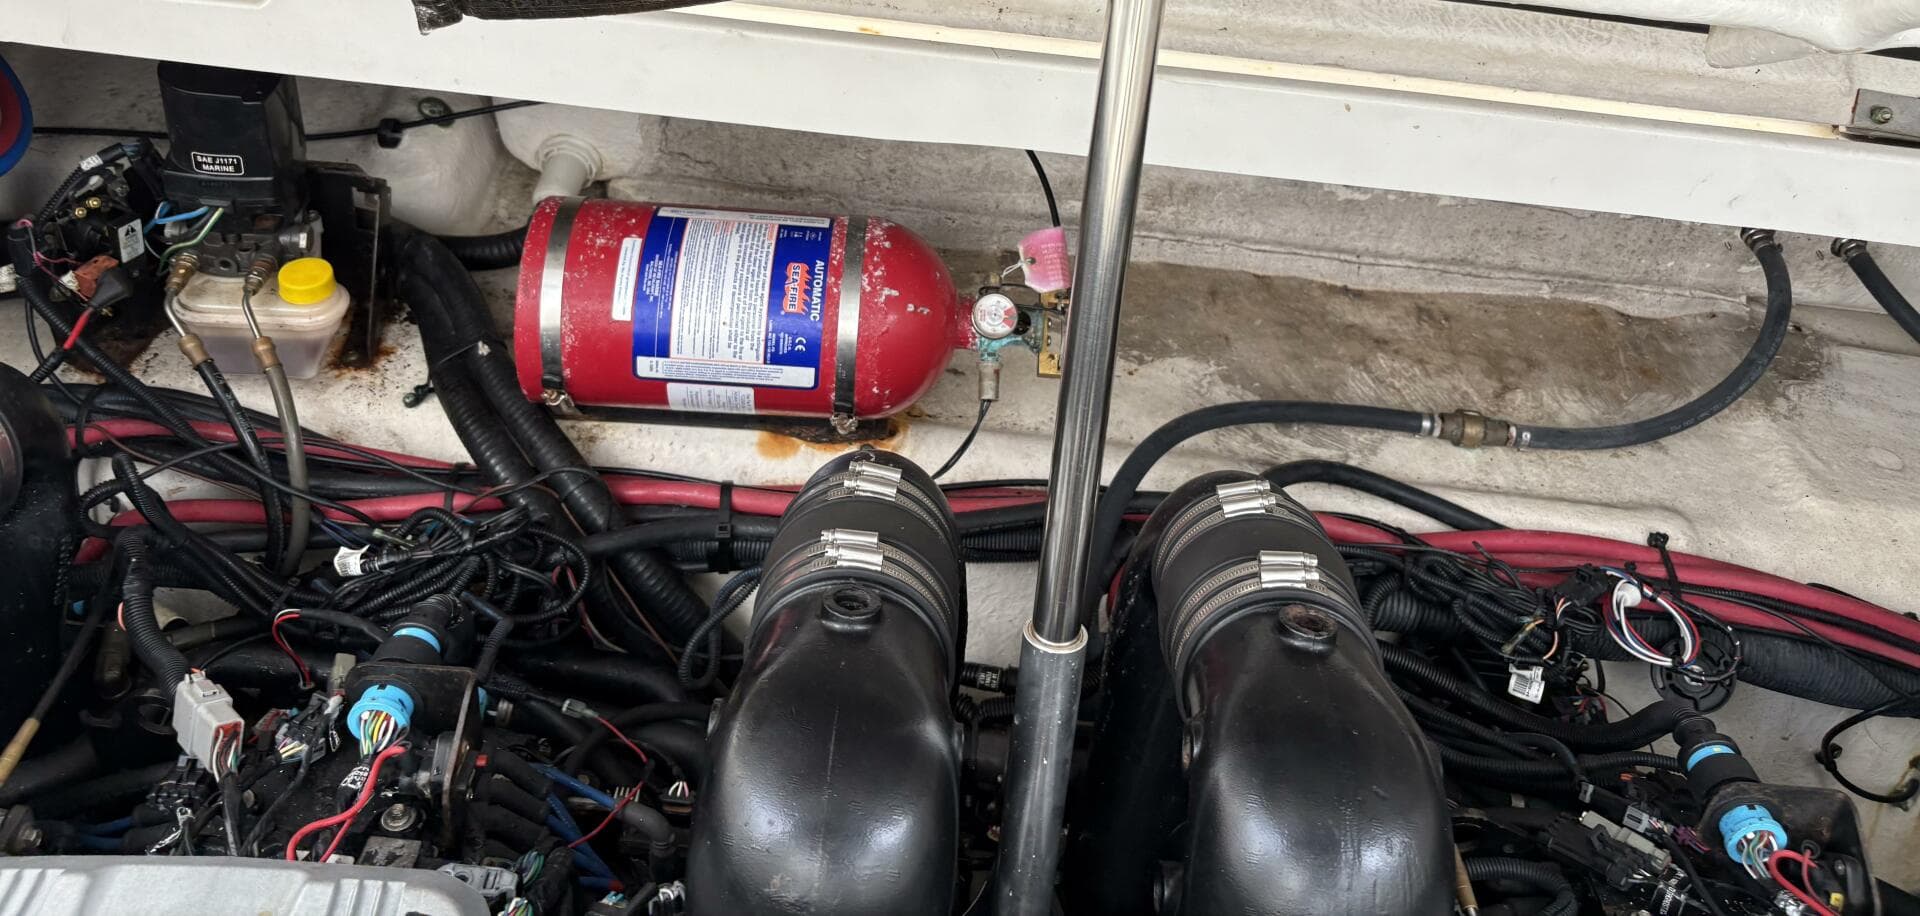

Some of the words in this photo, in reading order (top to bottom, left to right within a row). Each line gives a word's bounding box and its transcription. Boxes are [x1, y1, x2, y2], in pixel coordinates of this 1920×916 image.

[197, 155, 213, 164] SAE
[215, 157, 238, 165] J1171
[202, 163, 235, 173] MARINE
[810, 259, 825, 322] AUTOMATIC
[794, 337, 807, 352] CE
